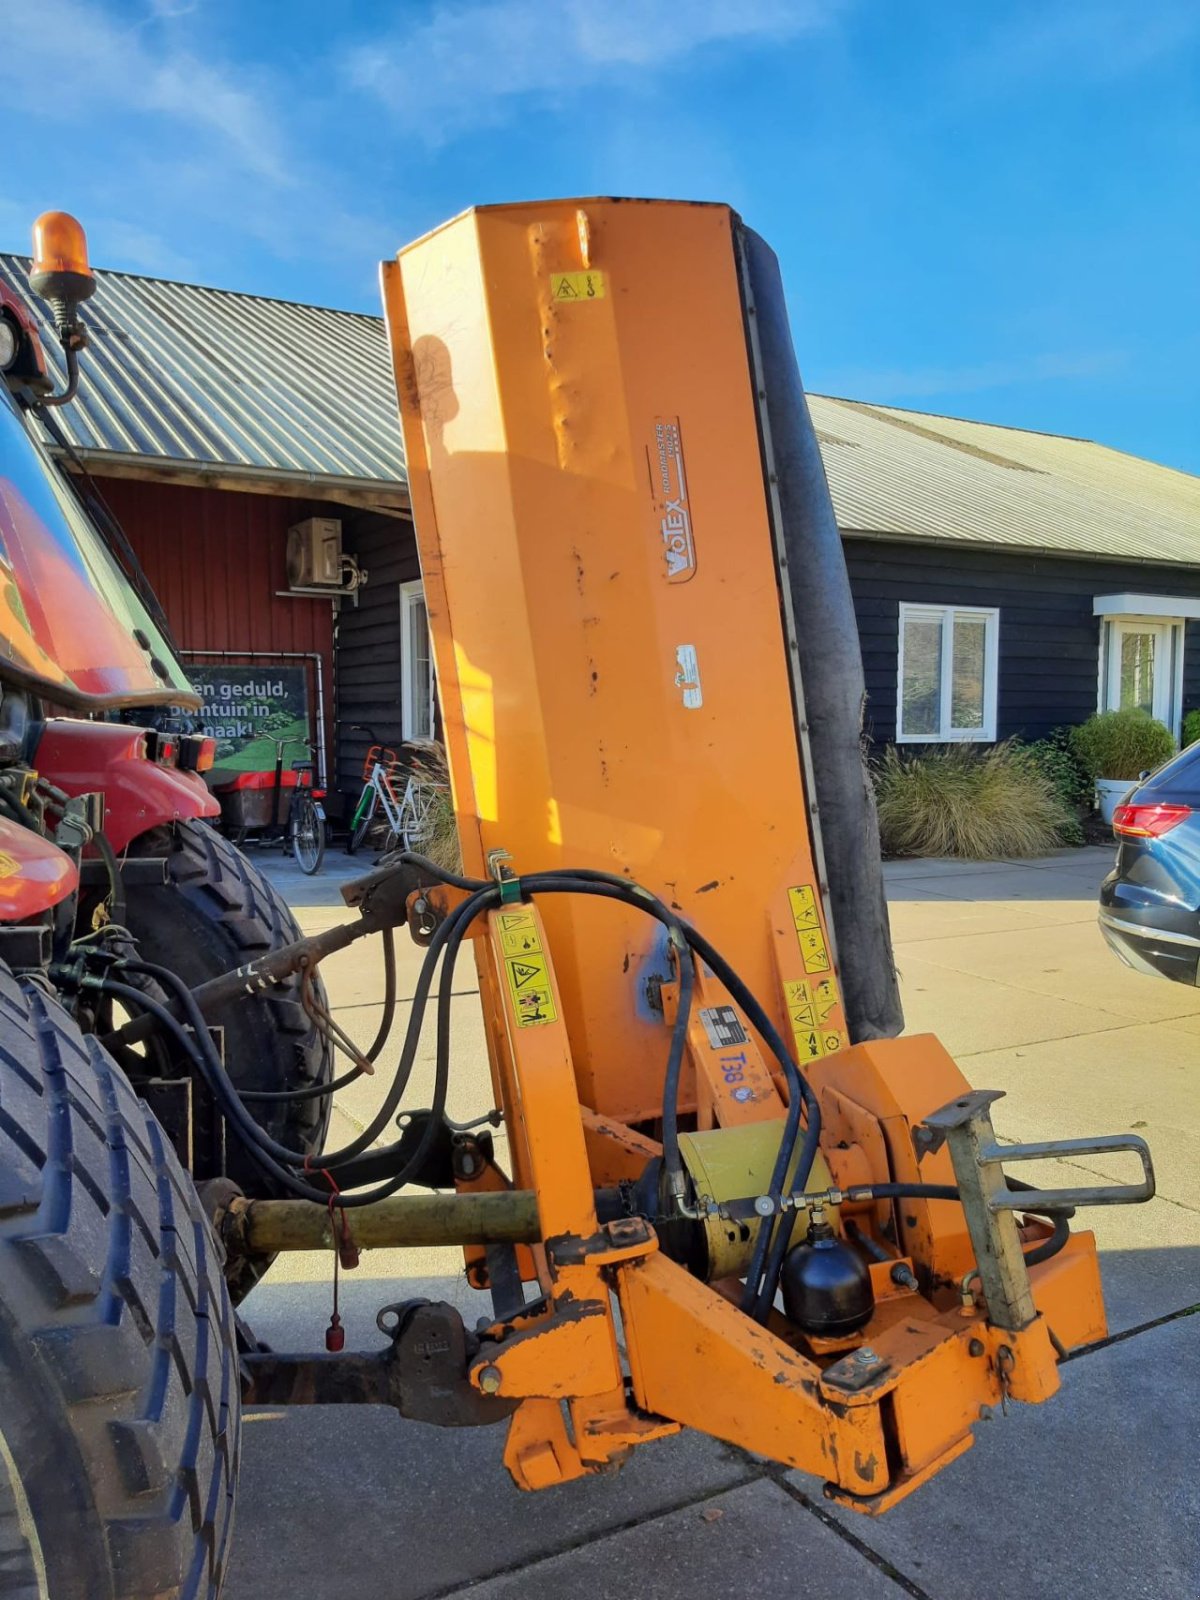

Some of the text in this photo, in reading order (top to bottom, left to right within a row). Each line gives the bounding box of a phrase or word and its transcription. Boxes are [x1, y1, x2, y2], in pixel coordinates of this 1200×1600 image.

[655, 423, 671, 494] ROADMASTER
[220, 681, 289, 700] geduld,
[253, 702, 270, 717] in
[720, 1052, 746, 1083] T38
